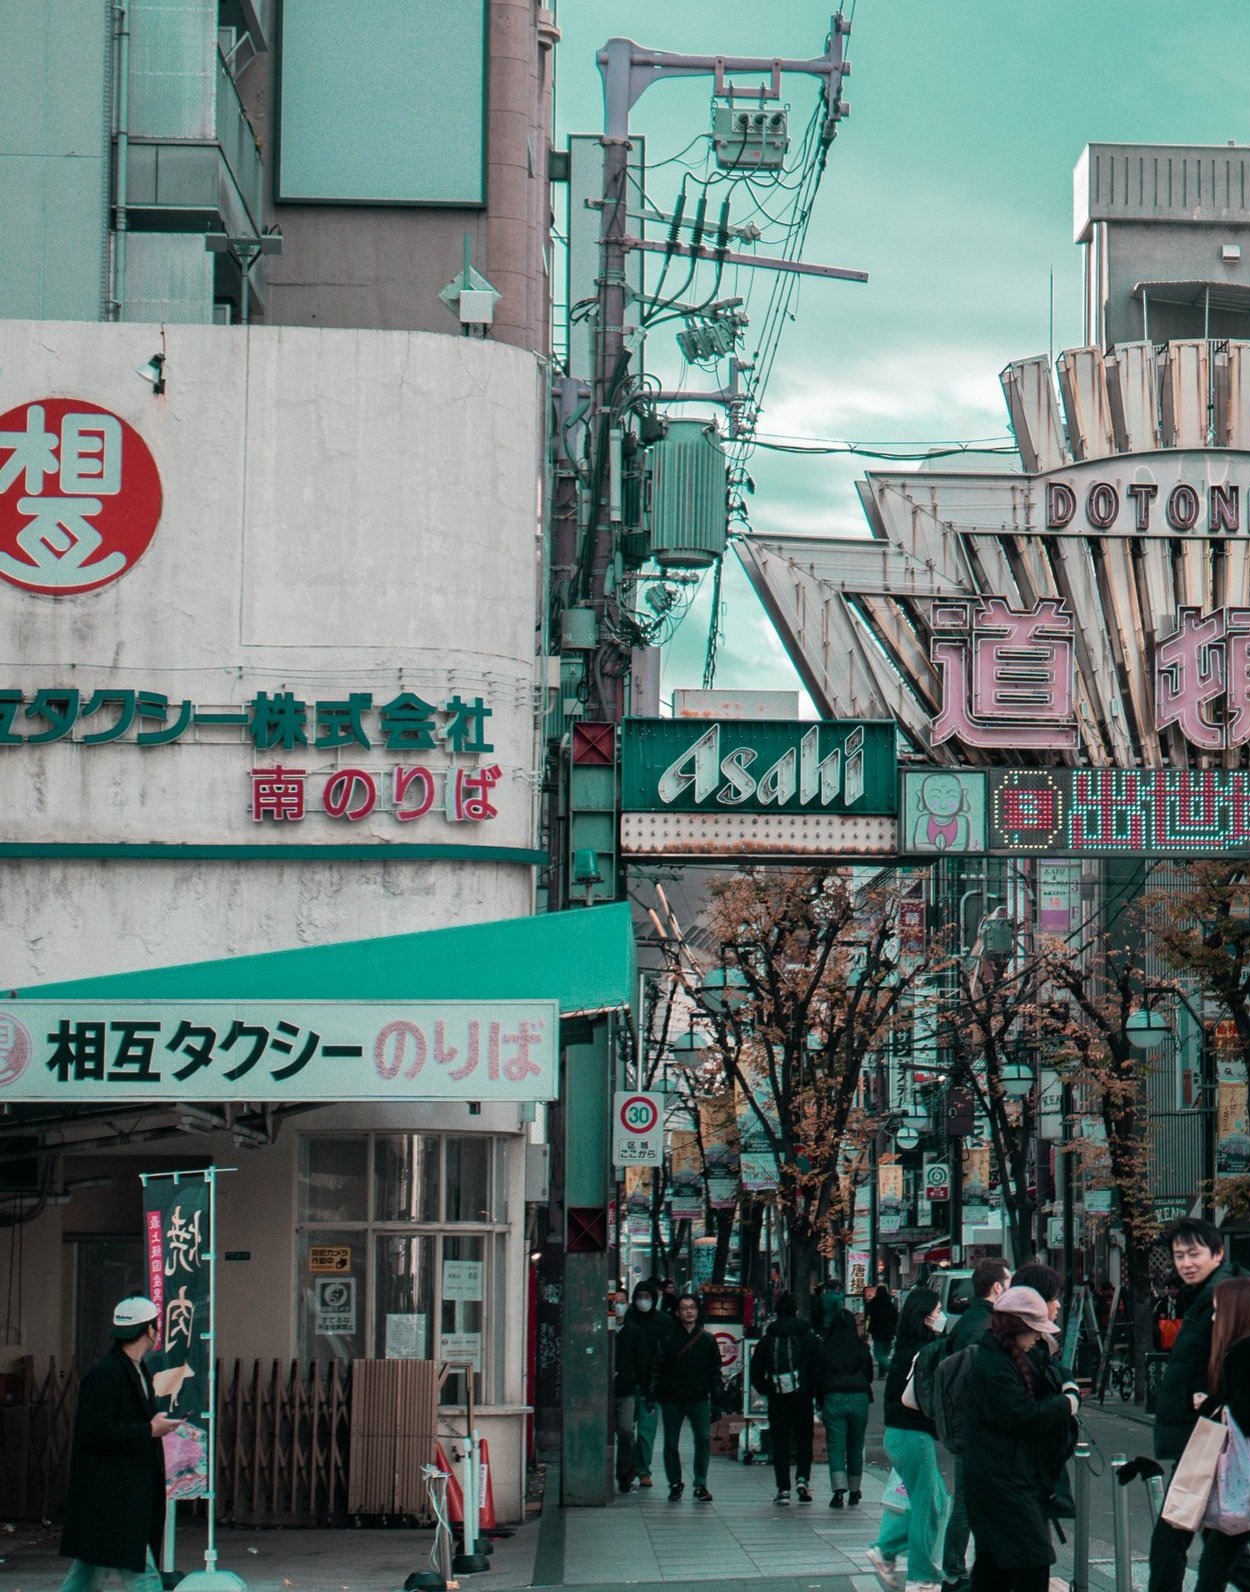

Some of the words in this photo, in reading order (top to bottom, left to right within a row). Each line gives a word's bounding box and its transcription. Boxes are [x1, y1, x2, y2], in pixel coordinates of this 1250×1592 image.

[658, 722, 866, 806] Asahi
[251, 764, 502, 822] 南のりば
[628, 1106, 650, 1124] 30
[620, 1150, 657, 1159] ここから
[311, 1249, 348, 1257] 防犯カメラ
